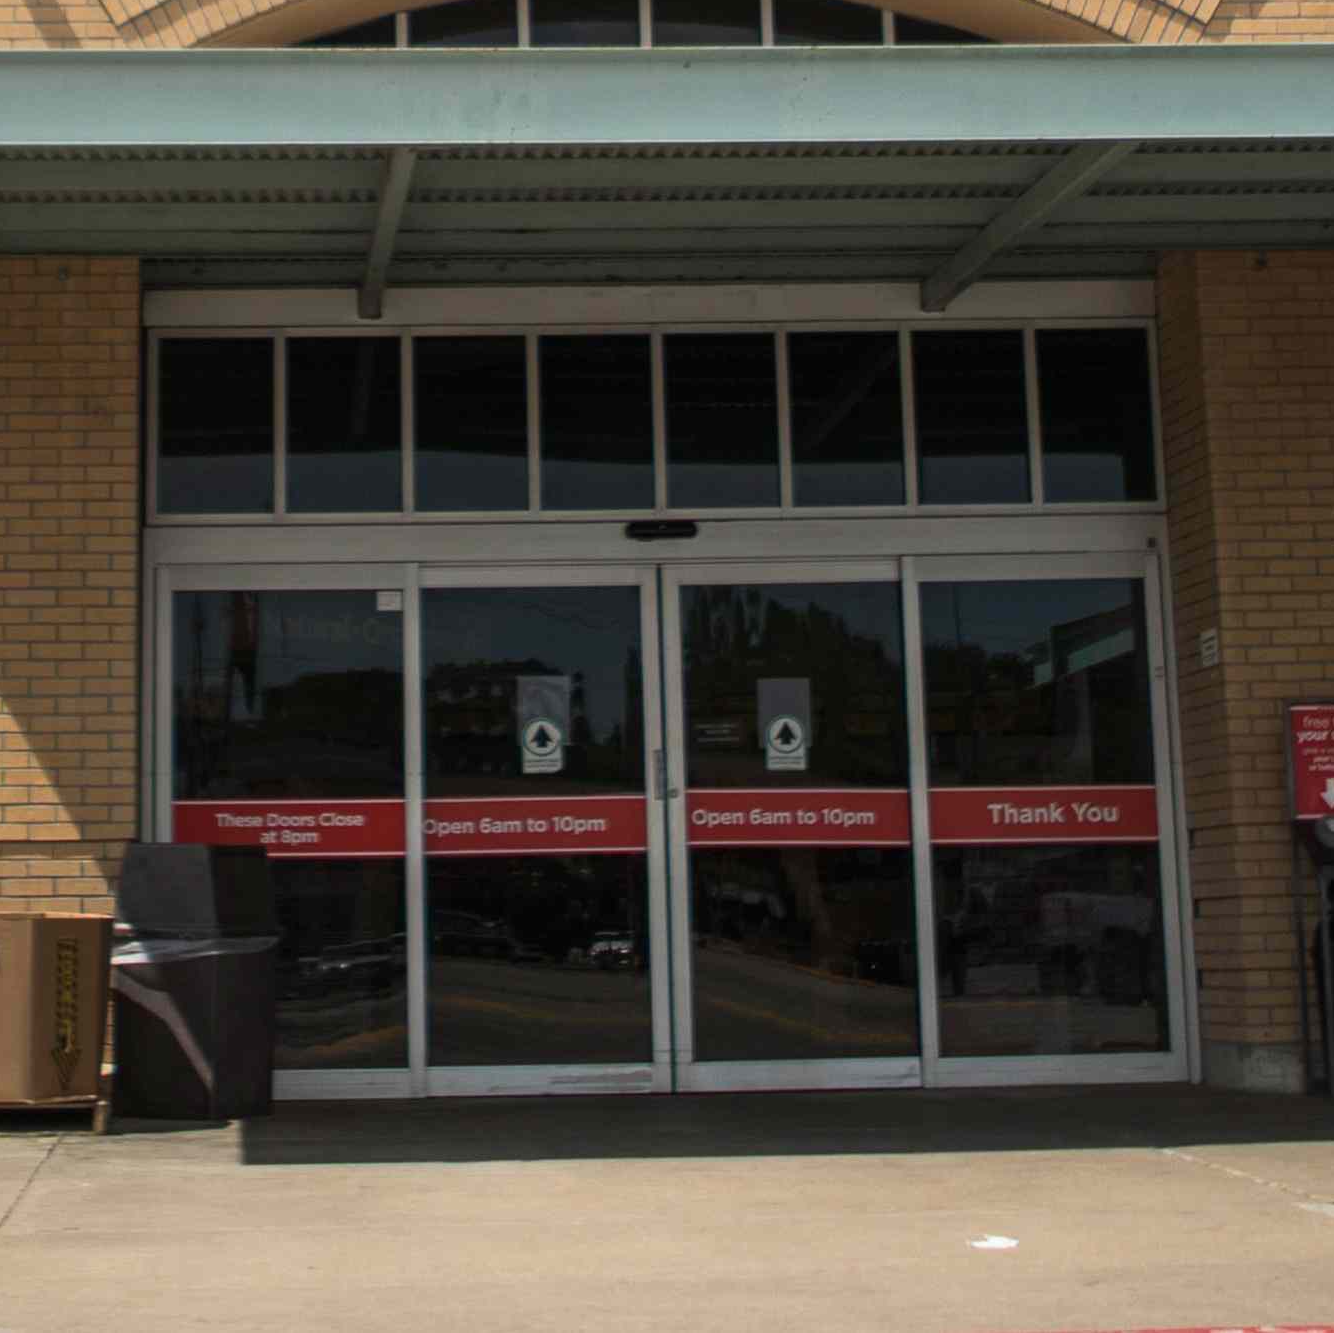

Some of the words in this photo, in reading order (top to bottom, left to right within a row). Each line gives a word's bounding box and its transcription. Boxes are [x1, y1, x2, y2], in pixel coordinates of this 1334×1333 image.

[216, 813, 263, 827] These
[267, 813, 315, 827] Doors
[319, 812, 365, 826] Close
[691, 809, 744, 828] Open
[749, 808, 791, 825] 6am
[796, 809, 817, 825] to
[823, 808, 875, 828] 10pm
[987, 802, 1066, 825] Thank
[1071, 802, 1120, 822] You
[424, 818, 475, 837] Open
[479, 817, 522, 834] 6am
[527, 817, 547, 832] to
[553, 816, 606, 835] 10pm
[260, 831, 277, 844] at
[281, 829, 319, 845] 8pm
